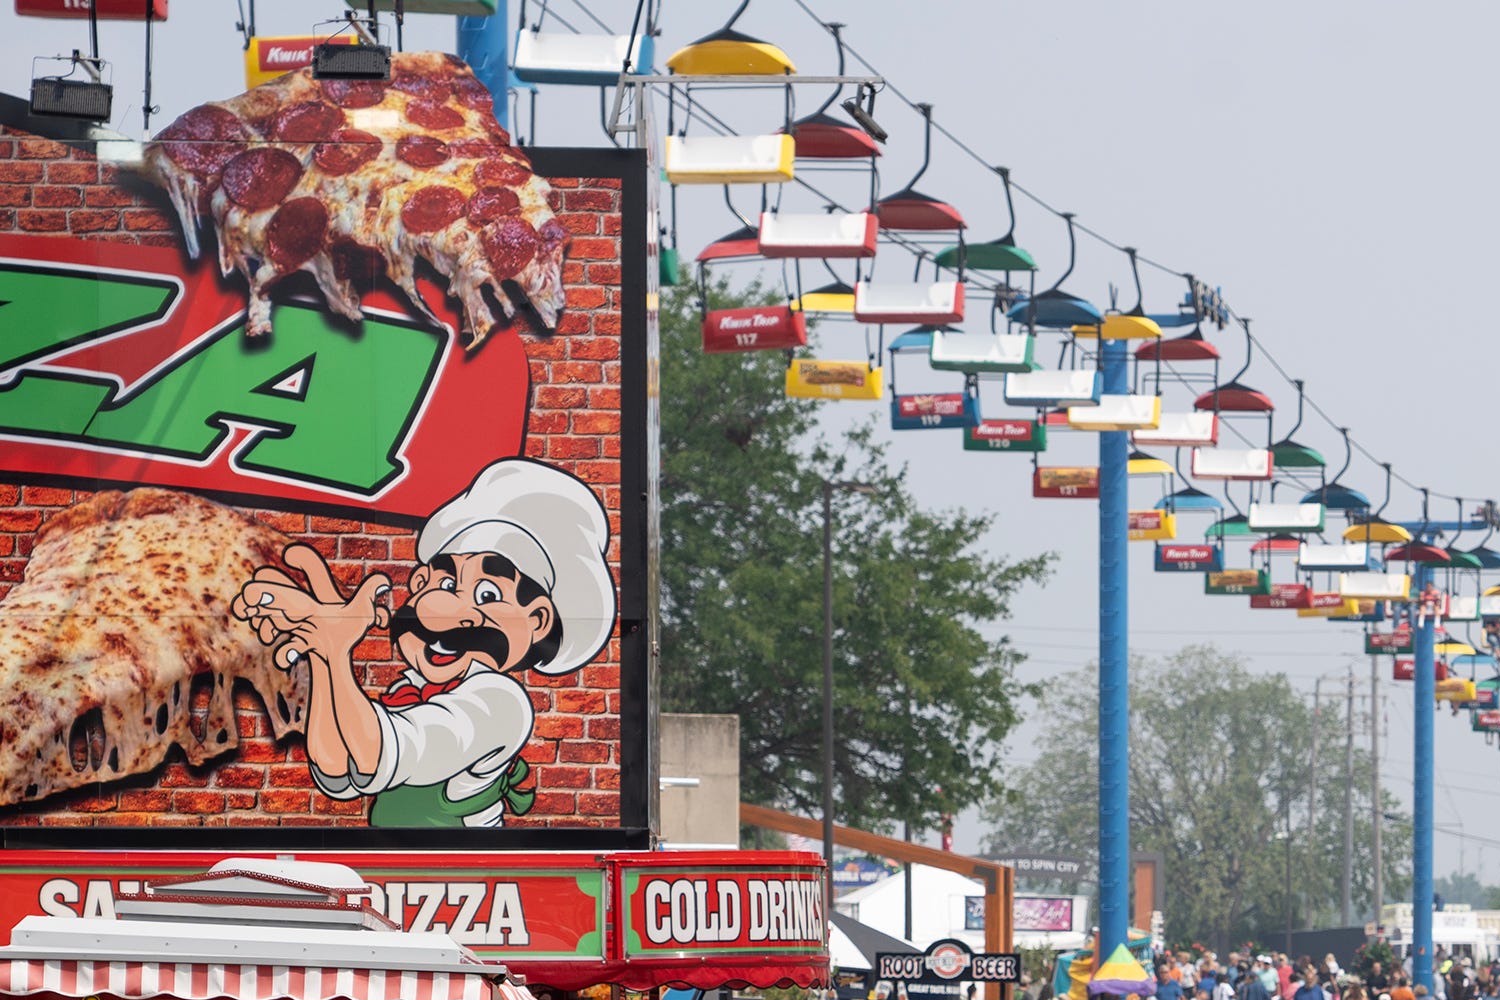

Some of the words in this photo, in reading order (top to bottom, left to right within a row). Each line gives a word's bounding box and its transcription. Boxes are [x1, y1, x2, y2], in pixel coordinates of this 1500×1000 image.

[735, 333, 757, 346] 117
[644, 879, 742, 945] COLD
[748, 878, 823, 944] DRINKS
[879, 955, 924, 979] ROOT
[972, 956, 1017, 980] BEER
